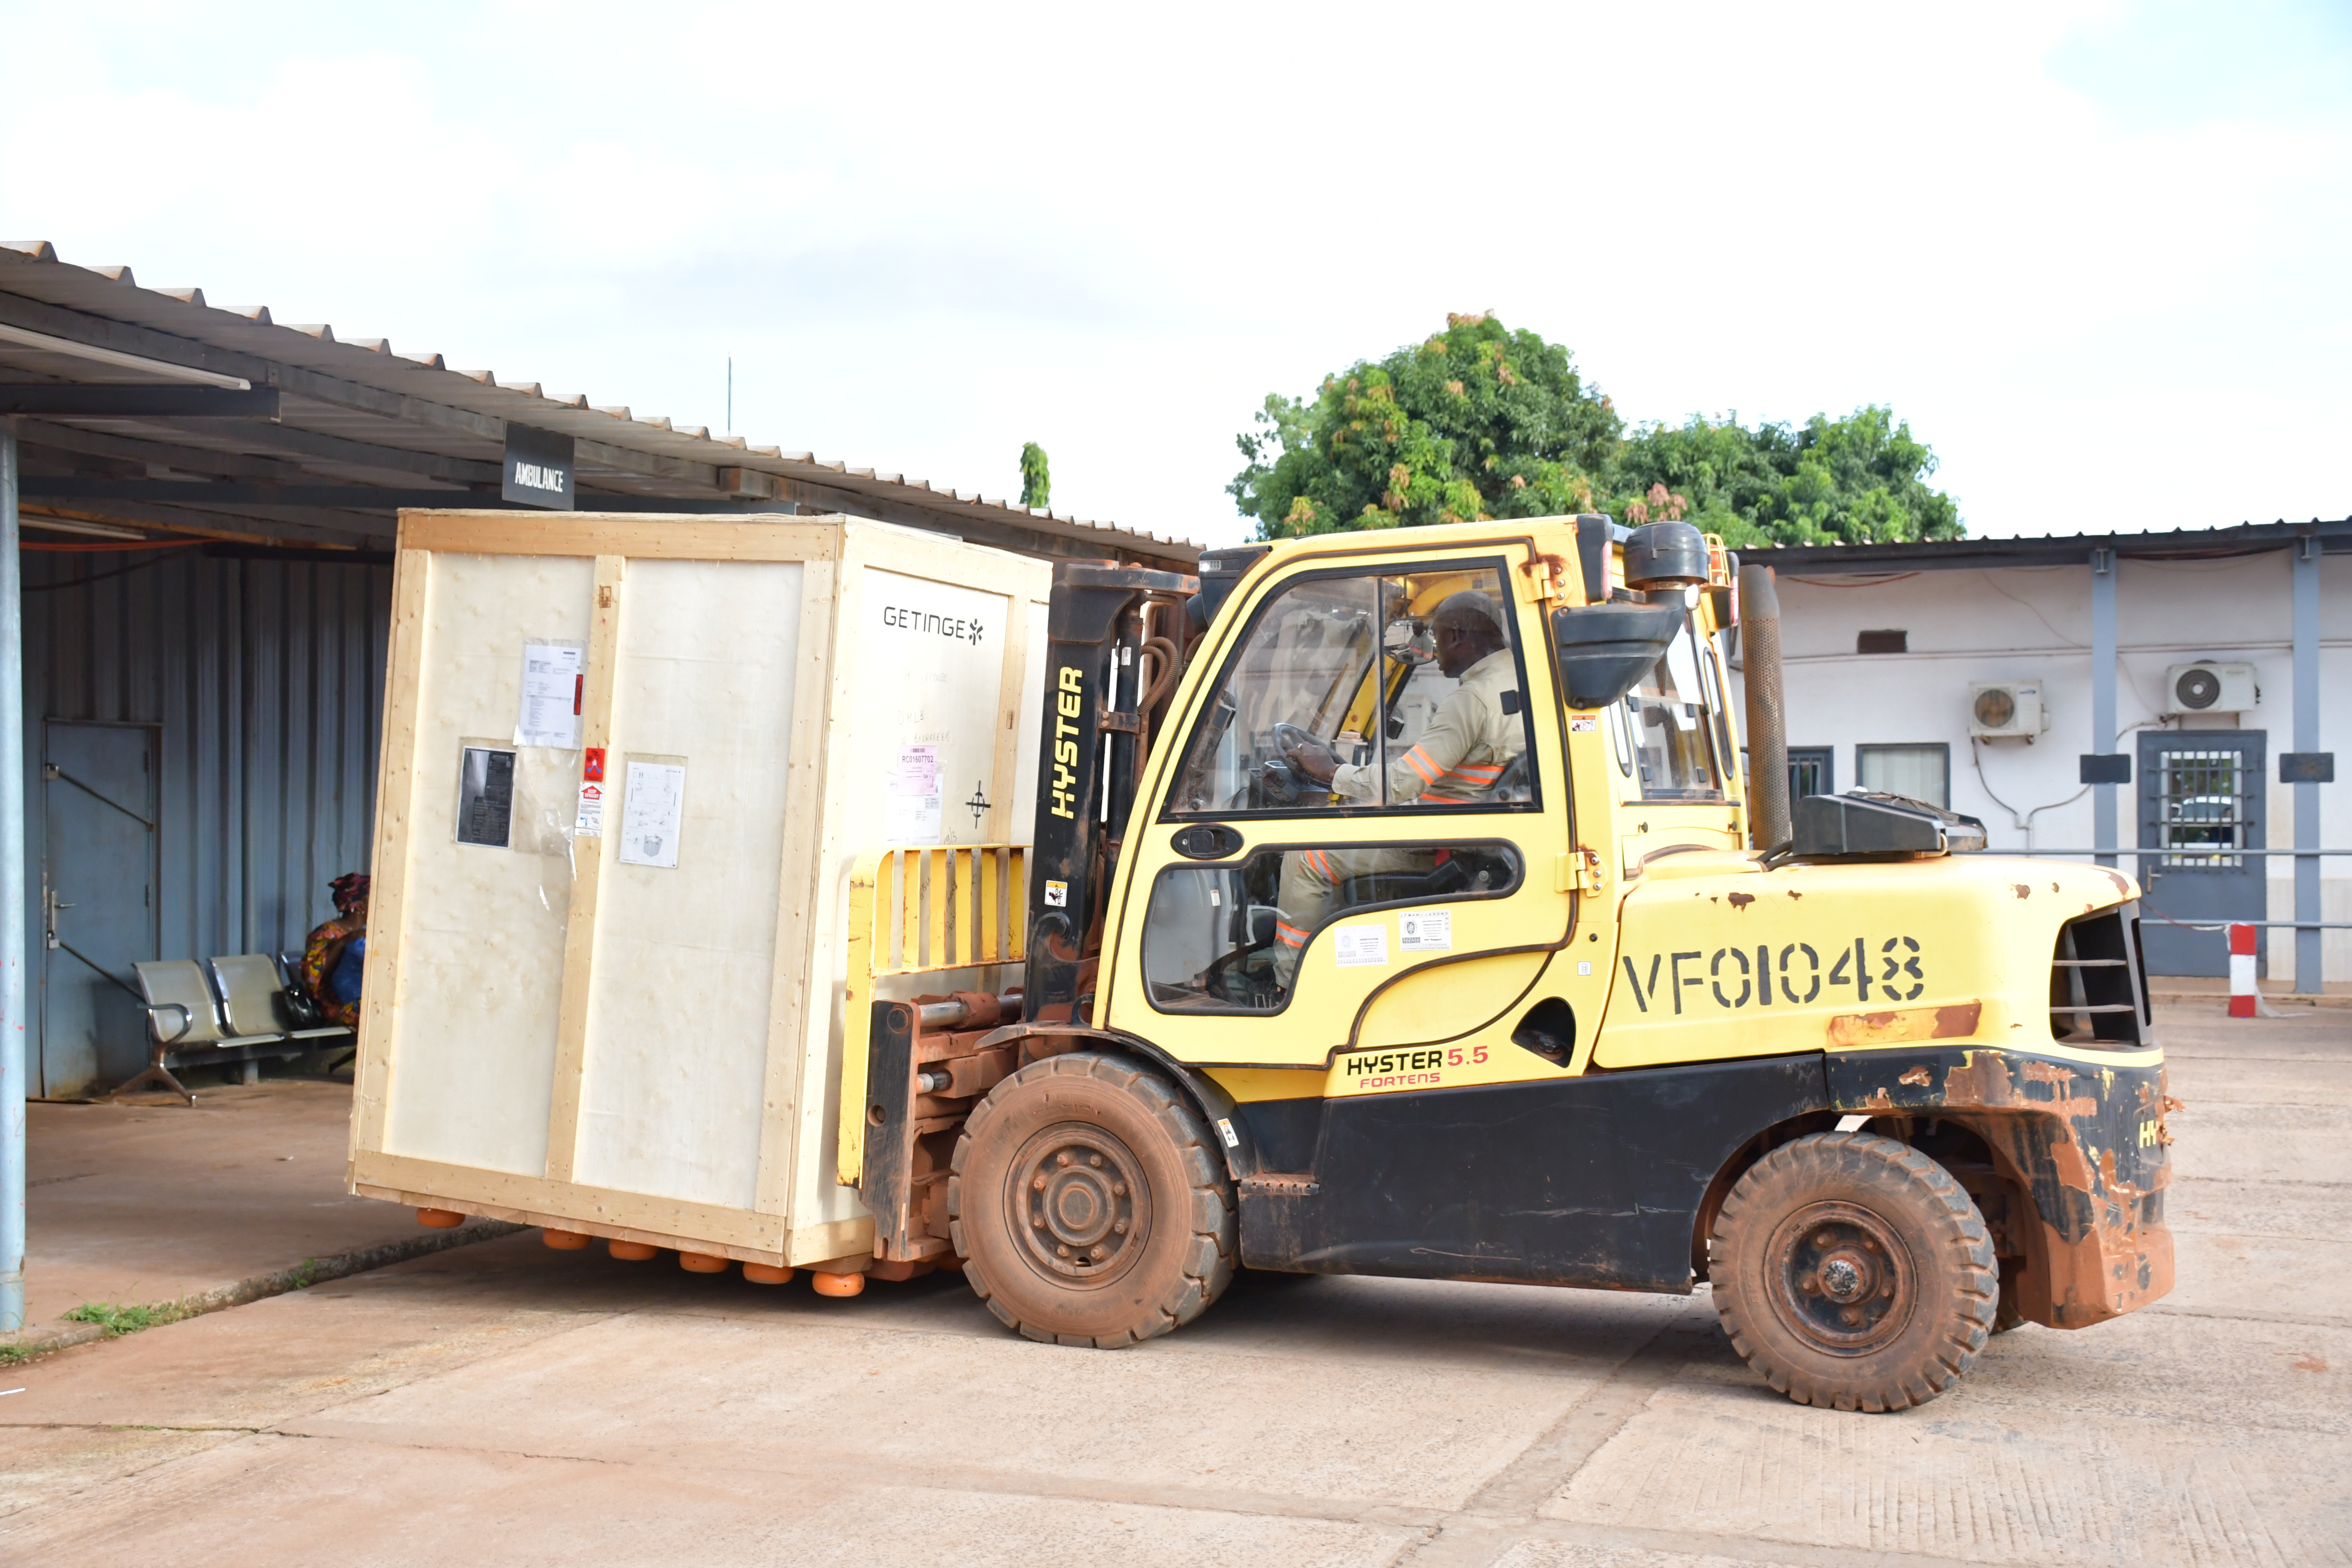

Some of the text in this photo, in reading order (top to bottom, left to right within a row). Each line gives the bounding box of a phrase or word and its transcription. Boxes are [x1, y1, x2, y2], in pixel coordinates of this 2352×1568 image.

[514, 461, 564, 493] AMBULANCE
[883, 606, 966, 639] GETINGE
[1051, 666, 1083, 819] HYSTER
[902, 755, 934, 763] RC01607702
[1622, 935, 1924, 1015] VF01048
[1347, 1045, 1489, 1076] HYSTER 5.5
[1360, 1072, 1440, 1089] FORTENS
